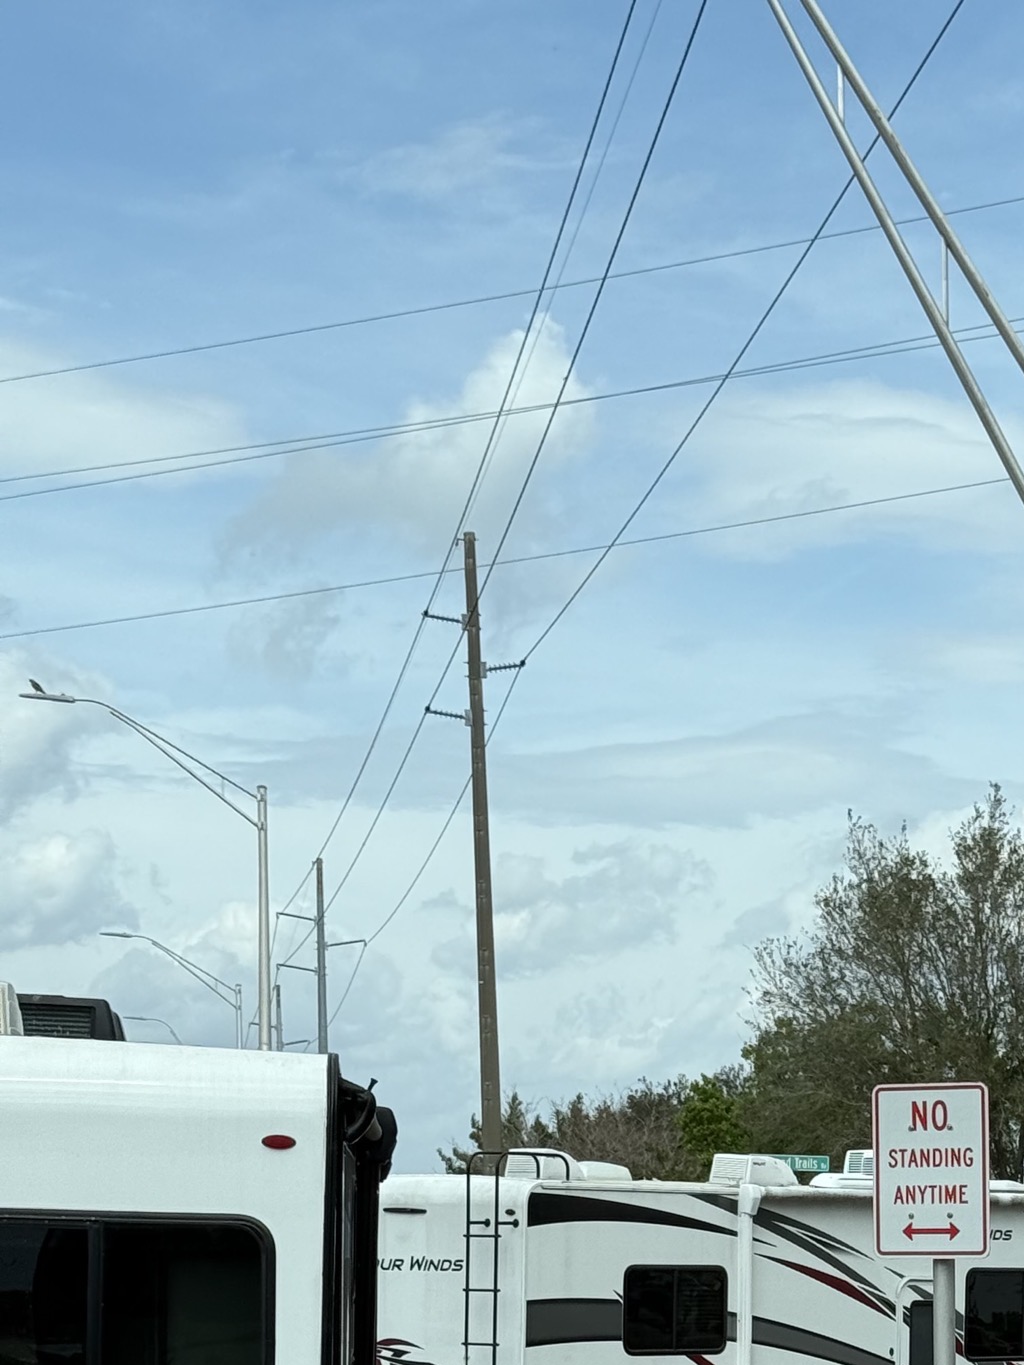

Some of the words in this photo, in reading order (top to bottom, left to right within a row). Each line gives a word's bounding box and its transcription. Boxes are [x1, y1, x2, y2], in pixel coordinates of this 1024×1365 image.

[911, 1100, 948, 1131] NO
[794, 1157, 818, 1169] Trails
[888, 1147, 974, 1168] STANDING
[893, 1184, 969, 1205] ANYTIME
[377, 1258, 404, 1271] UR
